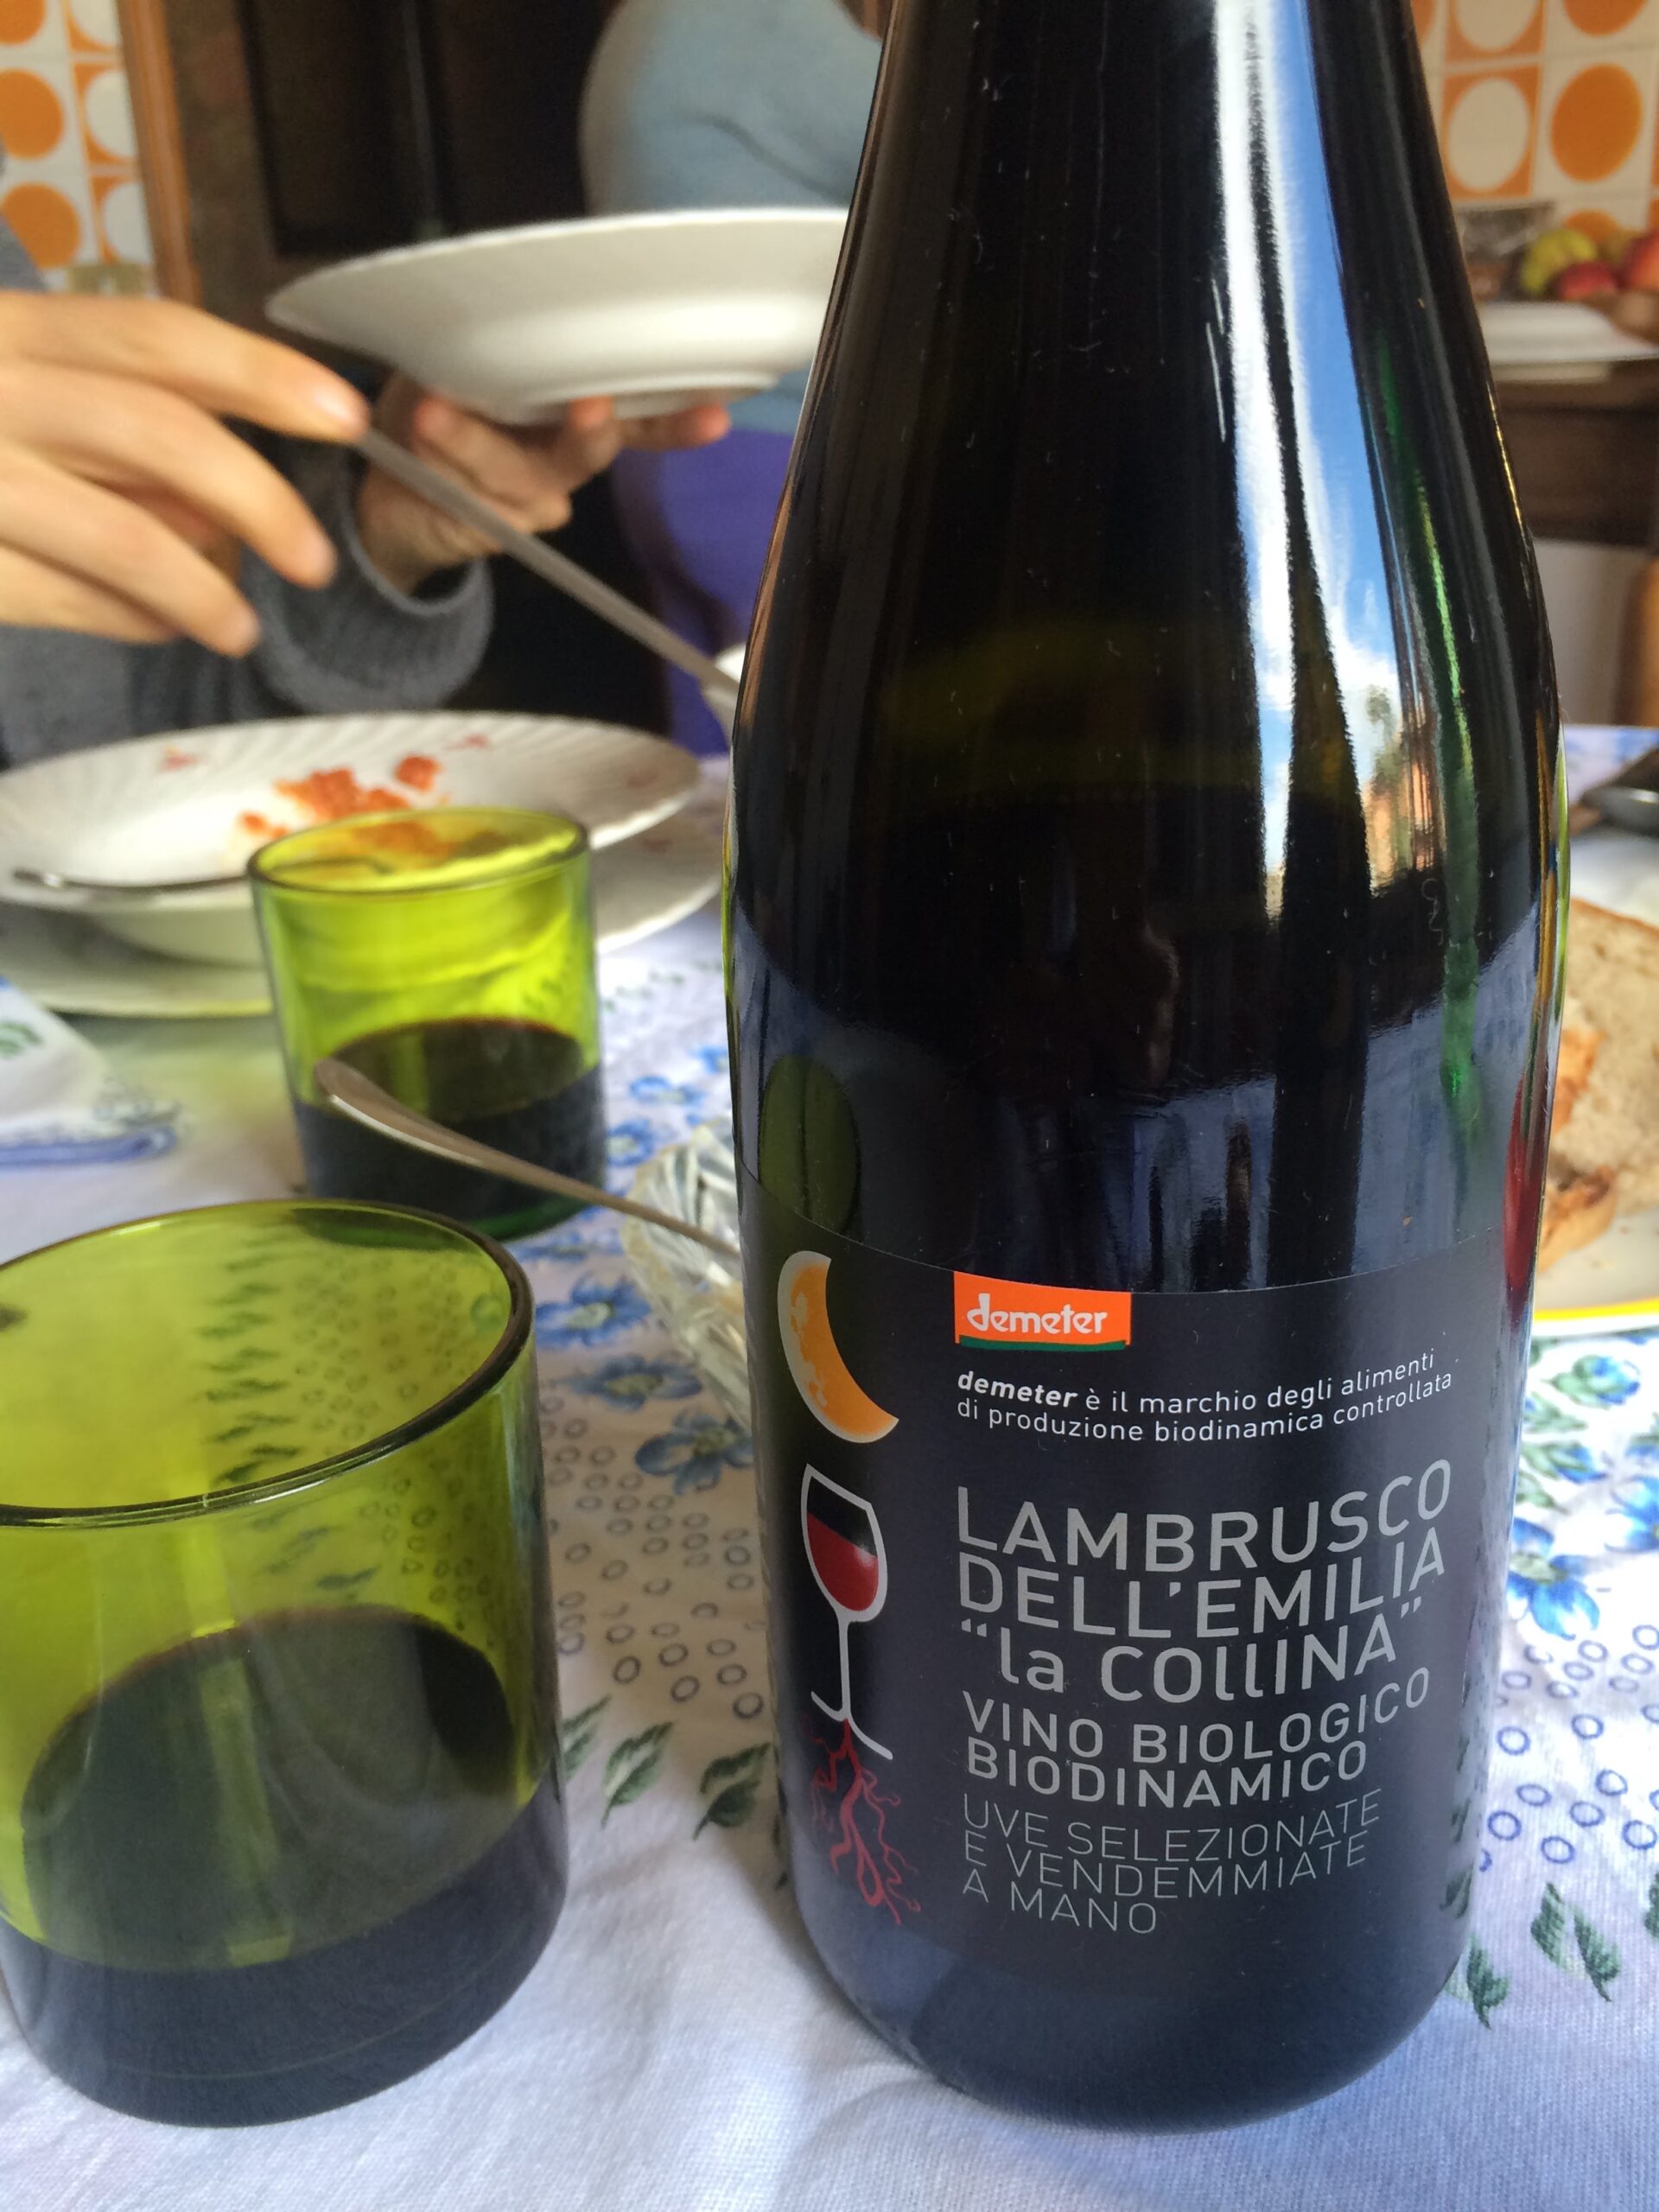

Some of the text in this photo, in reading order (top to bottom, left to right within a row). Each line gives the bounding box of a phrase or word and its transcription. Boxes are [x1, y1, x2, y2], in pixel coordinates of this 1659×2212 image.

[967, 1293, 1107, 1335] demeter
[957, 1370, 1452, 1442] di produzione biodinamica controllata
[958, 1348, 1434, 1414] demeter è il marchio degli alimenti
[957, 1459, 1451, 1572] LAMBRUSCO
[959, 1527, 1446, 1638] DELL'EMILIA
[963, 1667, 1429, 1764] VINO BIOLOGICO
[967, 1736, 1366, 1808] BIODINAMICO
[963, 1788, 1382, 1863] UVE SELEZIONATE
[964, 1830, 1368, 1899] E VENDEMMIATE
[962, 1868, 1157, 1935] A MANO
